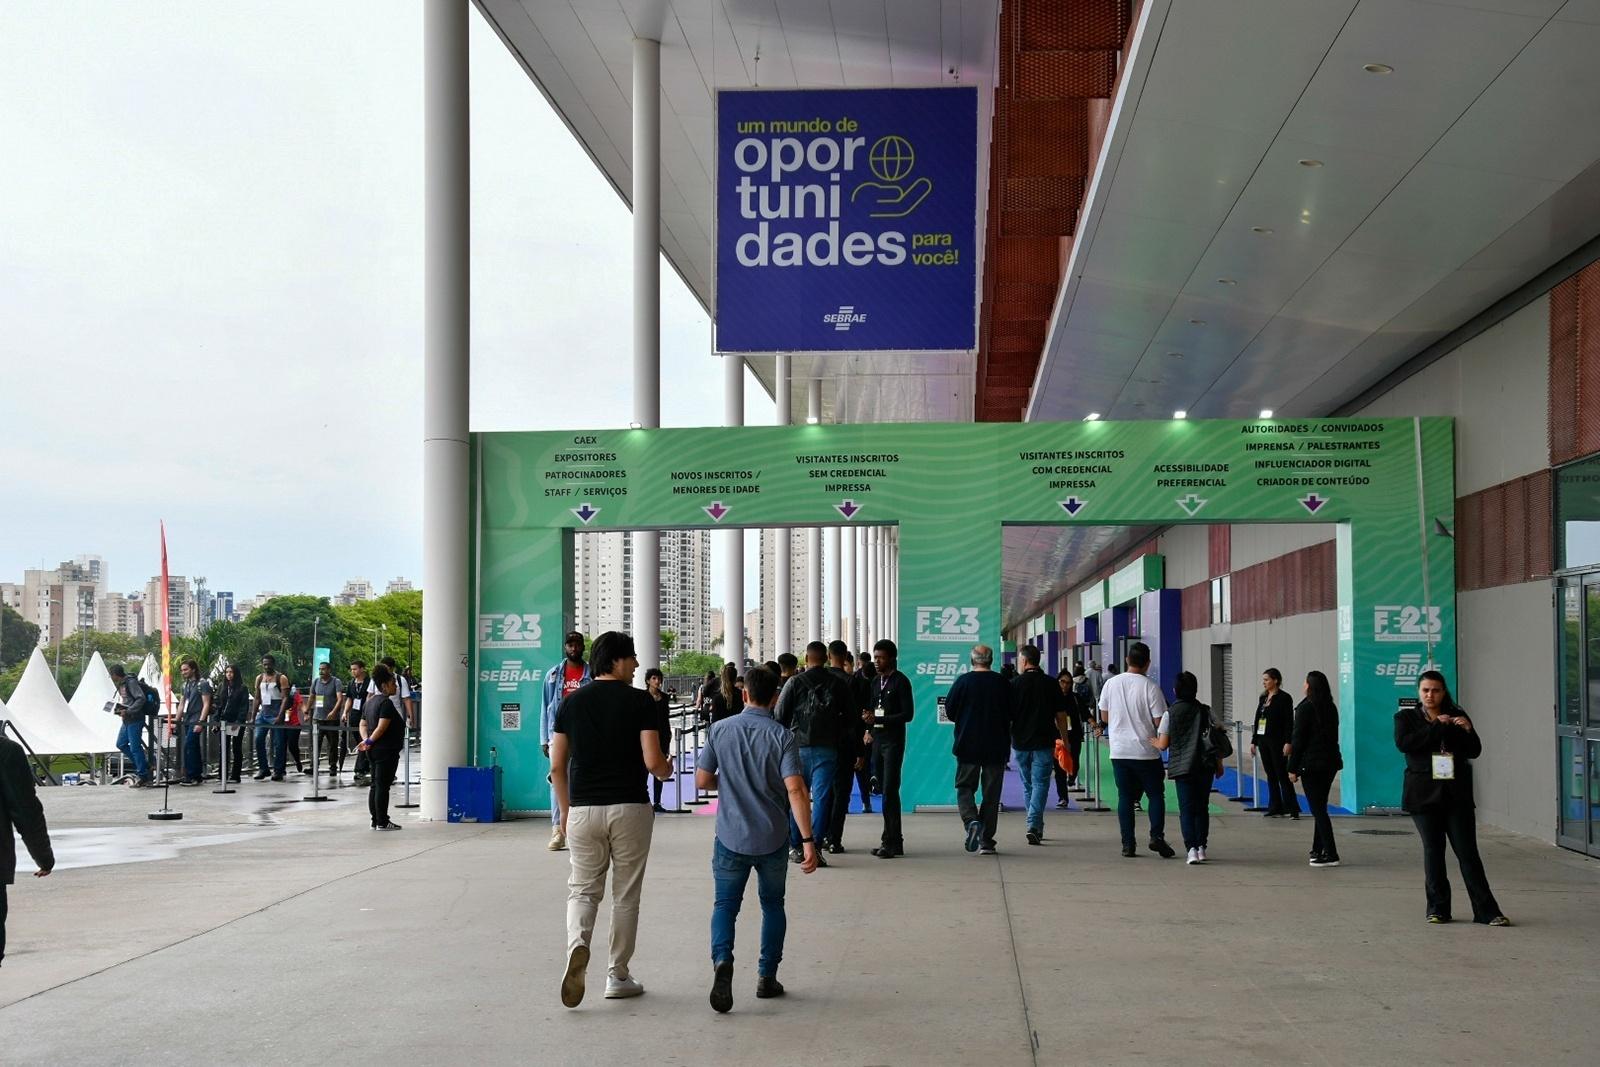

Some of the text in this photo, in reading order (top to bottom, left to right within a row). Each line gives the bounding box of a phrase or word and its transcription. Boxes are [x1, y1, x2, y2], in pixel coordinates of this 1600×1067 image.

[737, 117, 857, 133] um mundo de
[734, 136, 865, 182] opor
[736, 173, 840, 219] tuni
[736, 221, 906, 267] dades
[912, 234, 951, 248] para
[912, 250, 958, 265] você!
[824, 314, 866, 323] SEBRAE
[1242, 423, 1384, 433] AUTORIDADES / CONVIDADOS
[574, 436, 597, 444] CAEX
[1246, 441, 1380, 451] IMPRENSA / PALESTRANTES
[554, 453, 616, 462] EXPOSITORES
[796, 453, 899, 464] VISITANTES INSCRITOS
[1020, 450, 1124, 461] VISITANTES INSCRITOS
[1154, 463, 1229, 472] ACESSIBILIDADE
[1255, 459, 1371, 469] INFLUENCIADOR DIGITAL
[545, 470, 626, 479] PATROCINADORES
[809, 468, 886, 478] SEM CREDENCIAL
[1032, 465, 1112, 474] COM CREDENCIAL
[671, 471, 702, 480] NOVOS
[704, 471, 753, 480] INSCRITOS
[1257, 475, 1370, 486] CRIADOR DE CONTEÚDO
[825, 483, 871, 492] IMPRESSA
[1049, 479, 1096, 489] IMPRESSA
[1157, 478, 1226, 487] PREFERENCIAL
[545, 487, 628, 497] STAFF / SERVIÇOS
[672, 485, 760, 495] MENORES DE IDADE
[916, 663, 971, 675] SEBRA
[480, 670, 541, 681] SEBRAE
